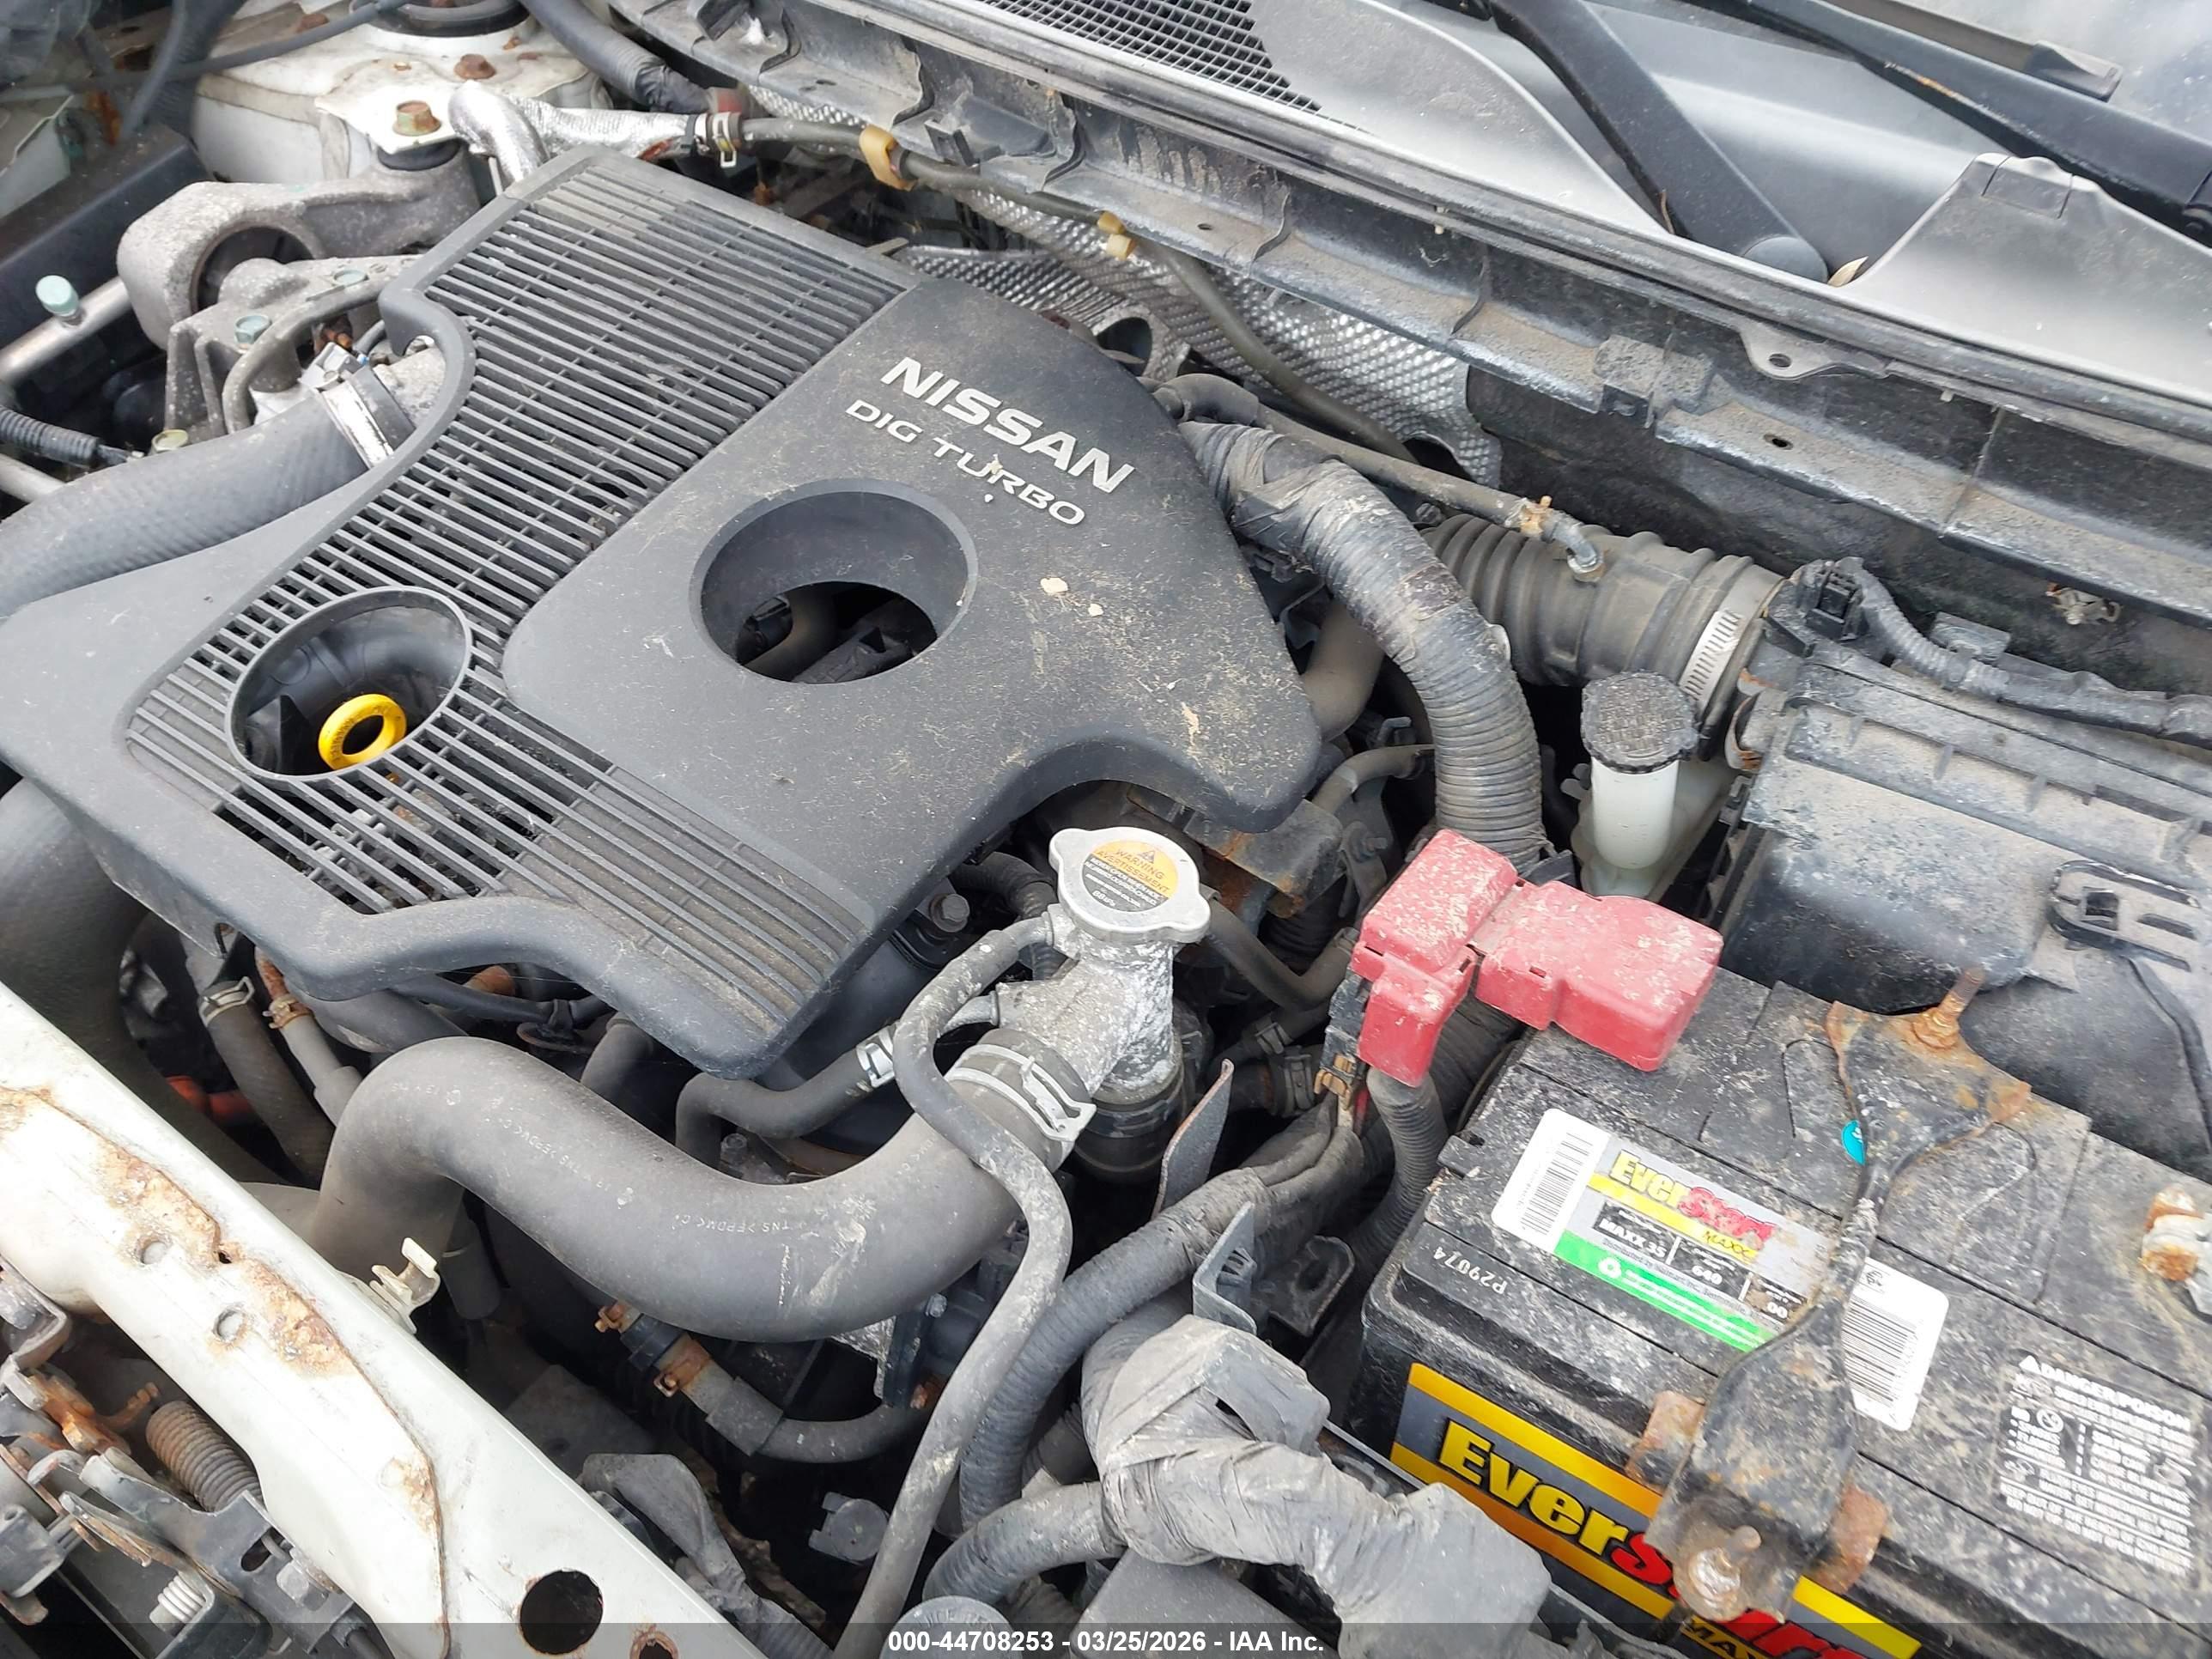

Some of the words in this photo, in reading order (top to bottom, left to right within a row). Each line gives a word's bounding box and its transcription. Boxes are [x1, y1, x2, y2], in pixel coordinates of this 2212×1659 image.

[880, 356, 1135, 493] NISSAN
[845, 399, 923, 443] DIG
[933, 436, 1085, 526] TURBO
[1097, 851, 1170, 893] AVERTISSEMENT
[1115, 848, 1165, 879] WARNING
[761, 1218, 789, 1233] TNS
[1598, 1216, 1647, 1249] MAXX
[1644, 1239, 1668, 1260] 35
[1690, 1261, 1724, 1287] 640
